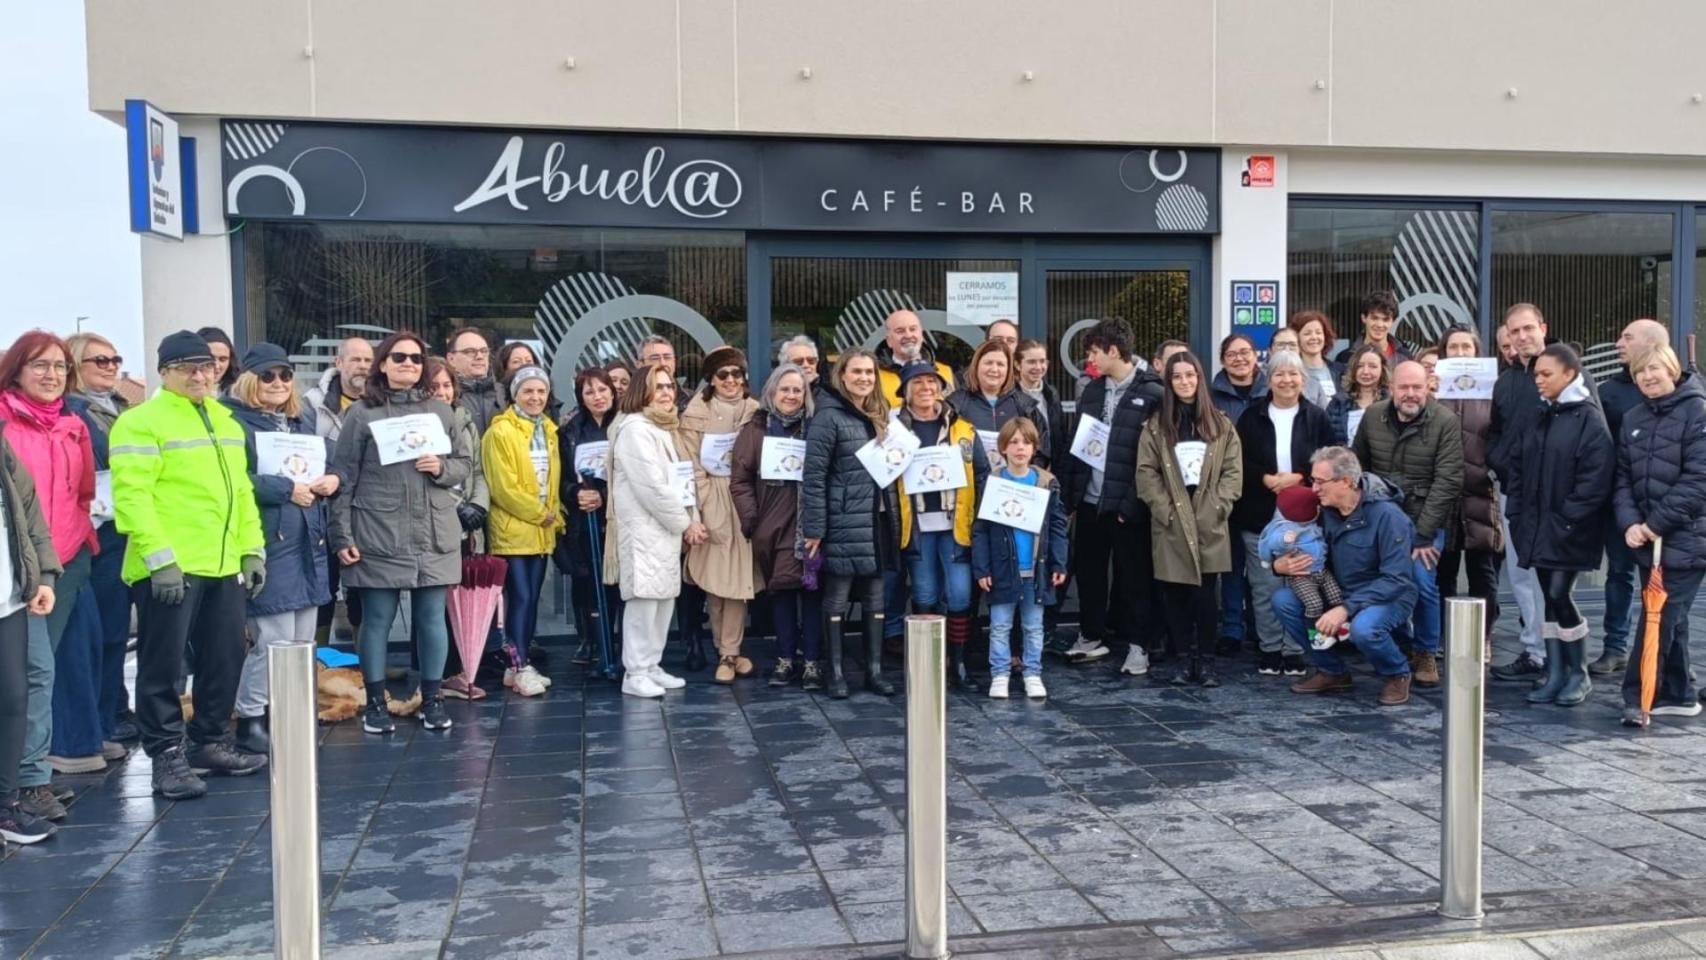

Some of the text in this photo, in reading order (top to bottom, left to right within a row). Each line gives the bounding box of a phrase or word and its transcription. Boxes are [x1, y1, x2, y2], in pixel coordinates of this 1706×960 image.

[453, 135, 1036, 218] Abuel@ CAFÉ-BAR
[959, 280, 1007, 290] CERRAMOS
[957, 293, 980, 301] LUNES
